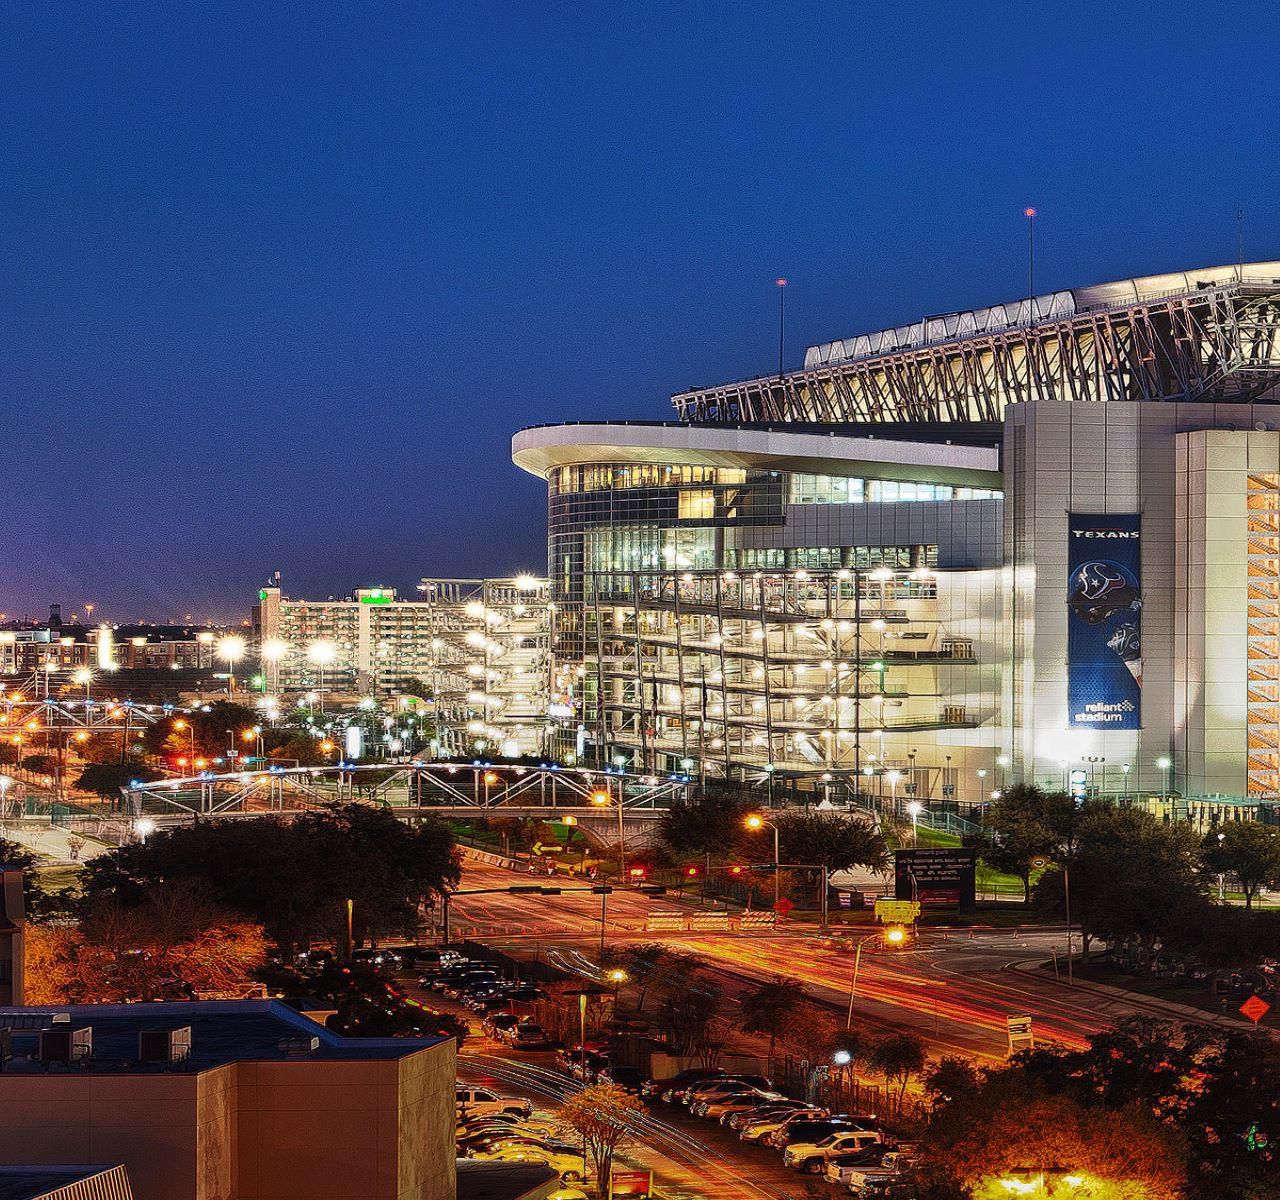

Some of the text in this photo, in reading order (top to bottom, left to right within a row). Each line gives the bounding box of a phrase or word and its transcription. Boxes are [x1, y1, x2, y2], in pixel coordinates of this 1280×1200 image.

[1072, 530, 1139, 538] TEXANS
[1085, 702, 1122, 712] reliant
[1074, 712, 1122, 722] stadium
